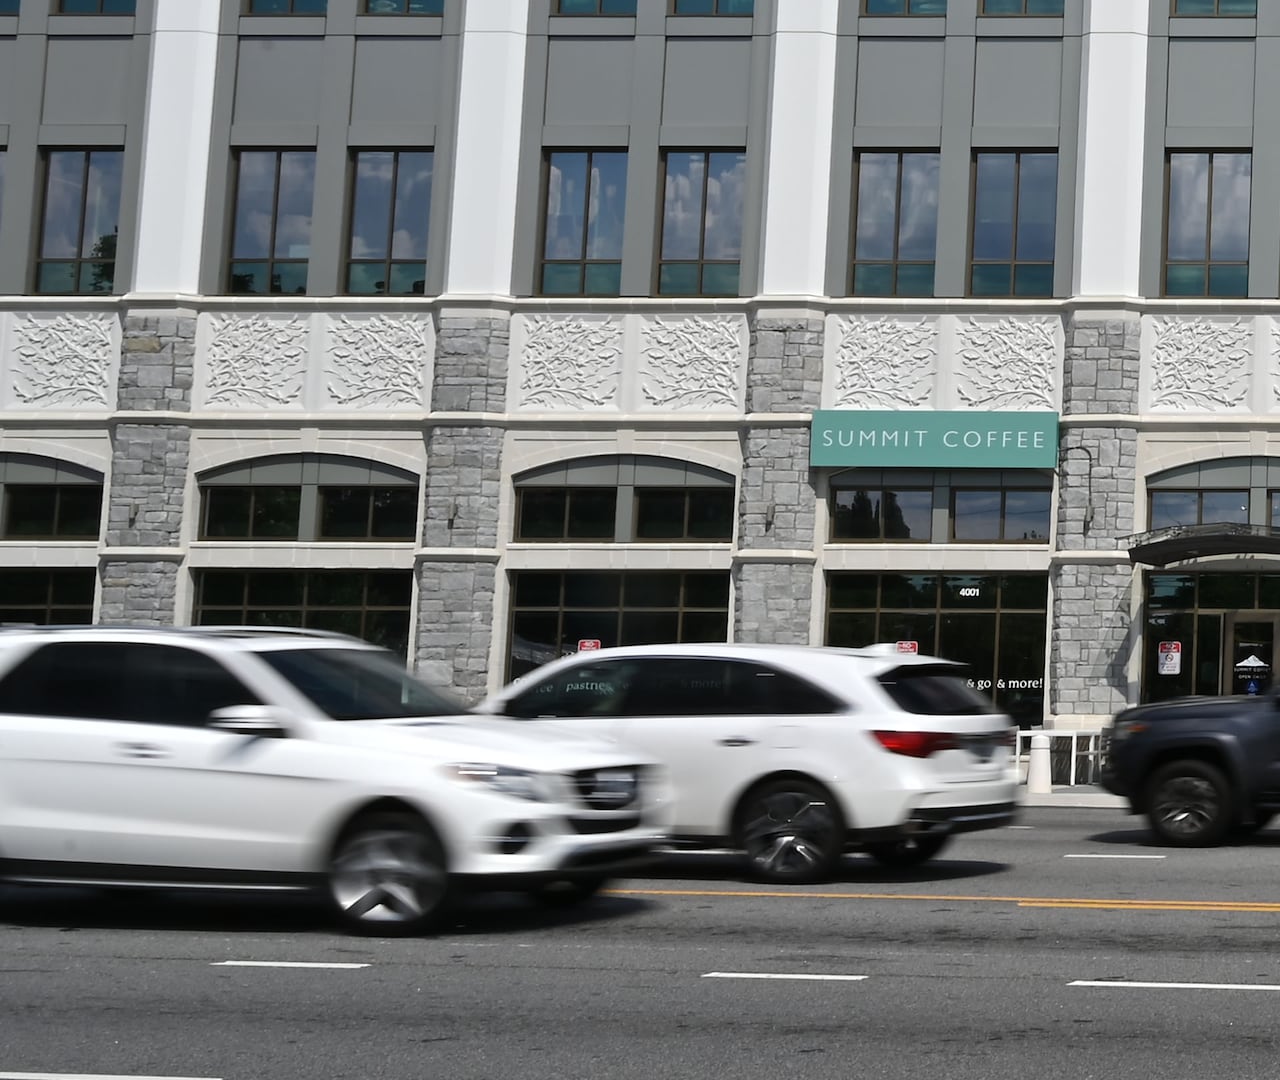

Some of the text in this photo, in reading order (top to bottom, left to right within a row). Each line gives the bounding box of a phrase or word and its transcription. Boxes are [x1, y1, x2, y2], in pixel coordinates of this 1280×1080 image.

[823, 430, 1045, 448] SUMMIT COFFEE
[959, 587, 980, 597] 4001
[977, 679, 992, 691] go
[996, 678, 1006, 689] &
[1008, 677, 1043, 689] more!
